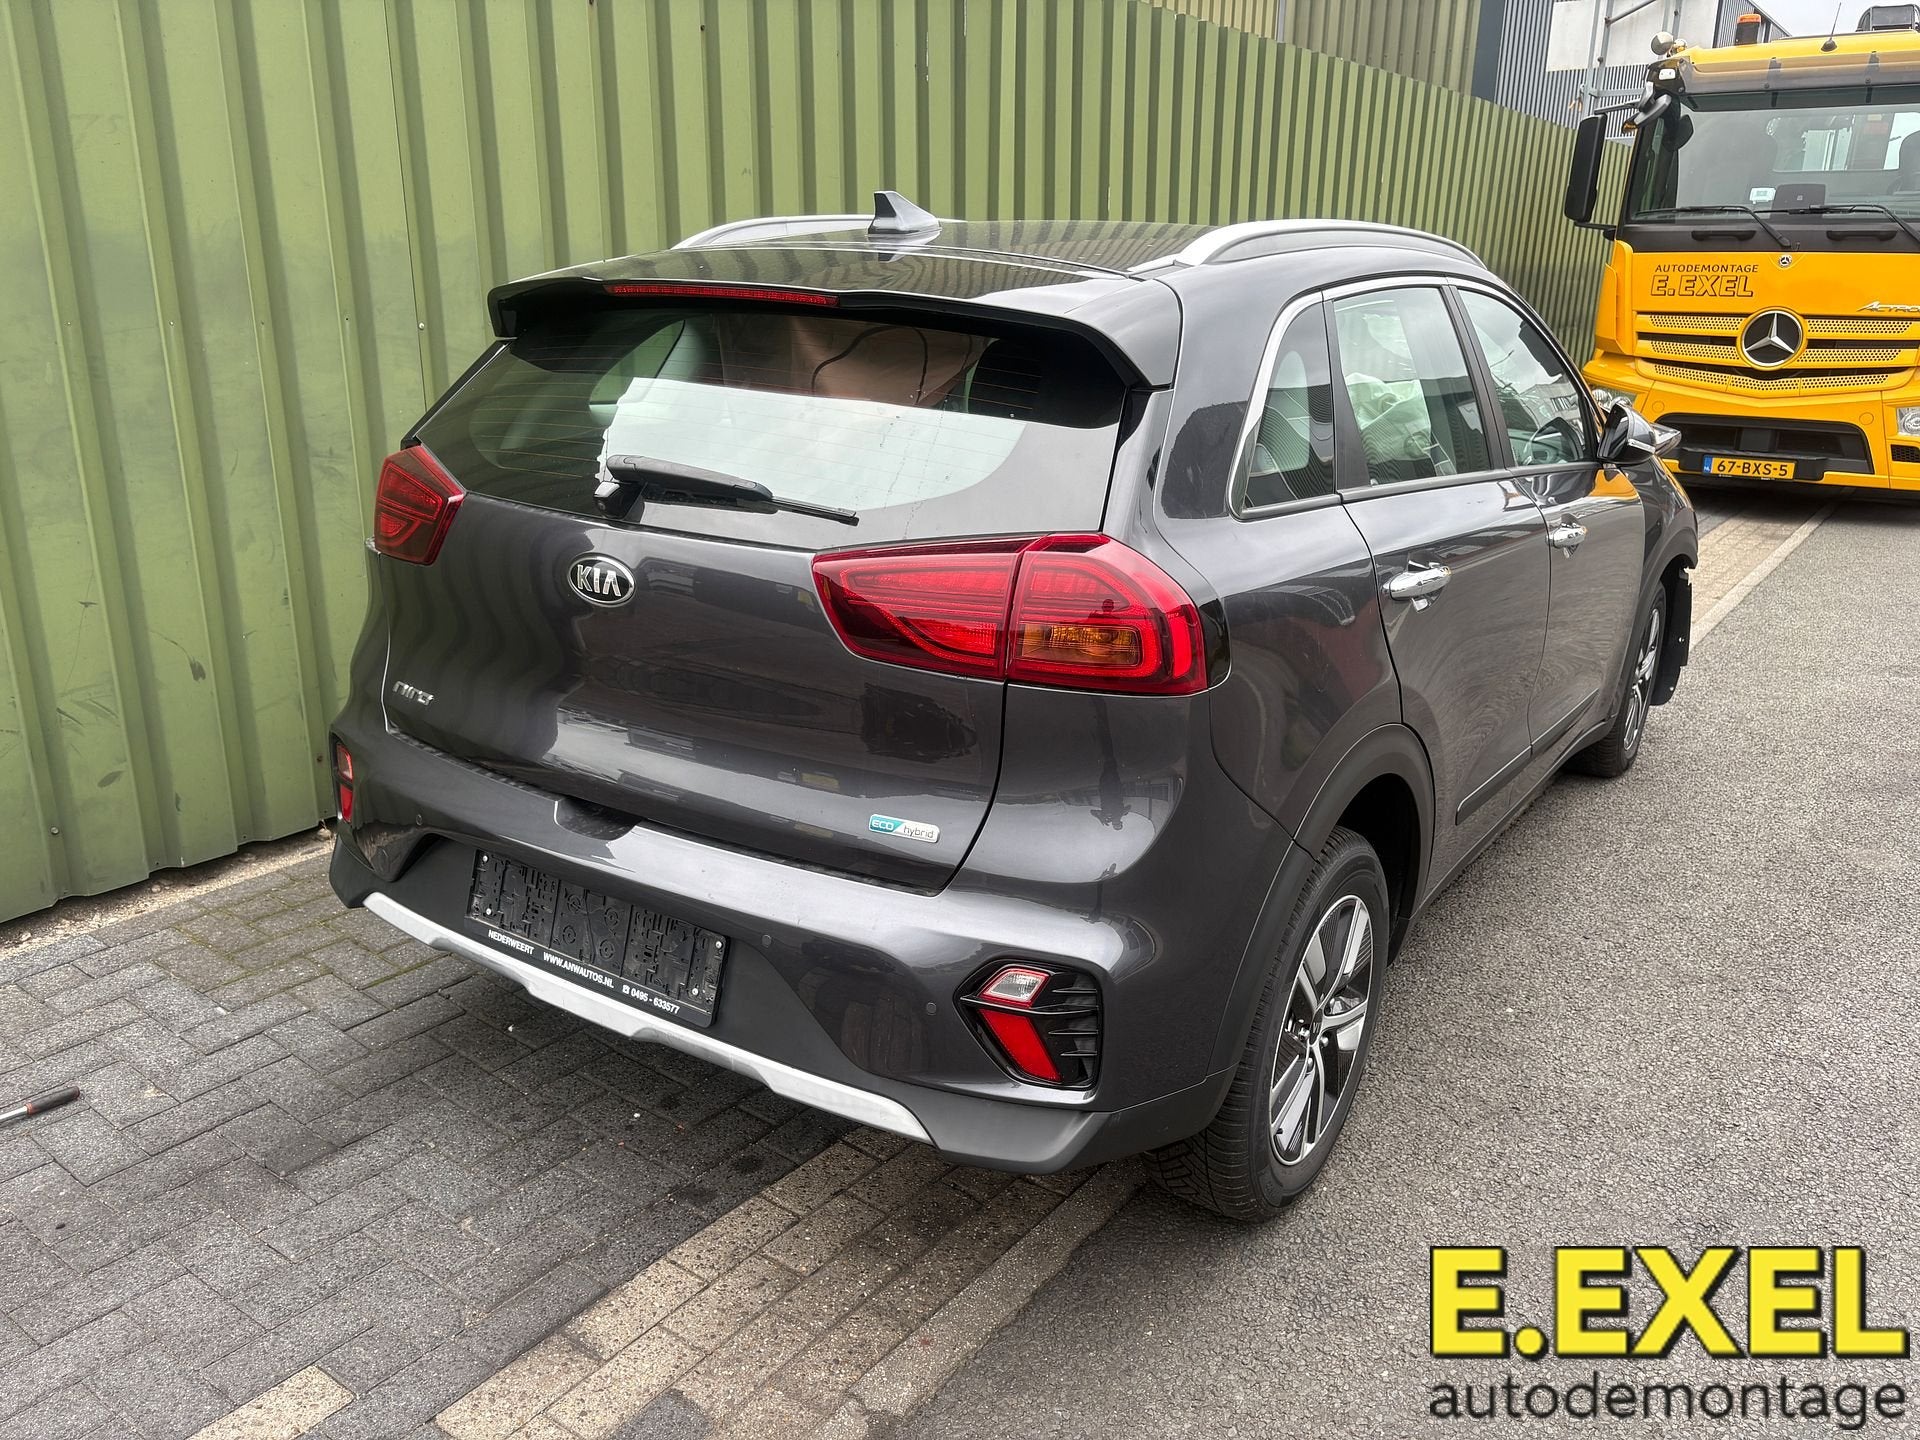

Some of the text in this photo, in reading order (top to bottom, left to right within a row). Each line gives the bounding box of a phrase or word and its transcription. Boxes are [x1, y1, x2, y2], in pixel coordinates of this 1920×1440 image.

[1654, 264, 1759, 273] AUTODEMONTAGE
[1651, 274, 1754, 298] E.EXEL
[1717, 460, 1788, 477] 67-BXS-5
[577, 564, 621, 597] KIA
[871, 820, 935, 839] ECO hybrid
[488, 929, 535, 955] NEDERWEERT
[543, 951, 615, 989] WWW.ANWAUTOS.NL
[630, 987, 649, 1002] 0495
[653, 997, 681, 1014] 633577
